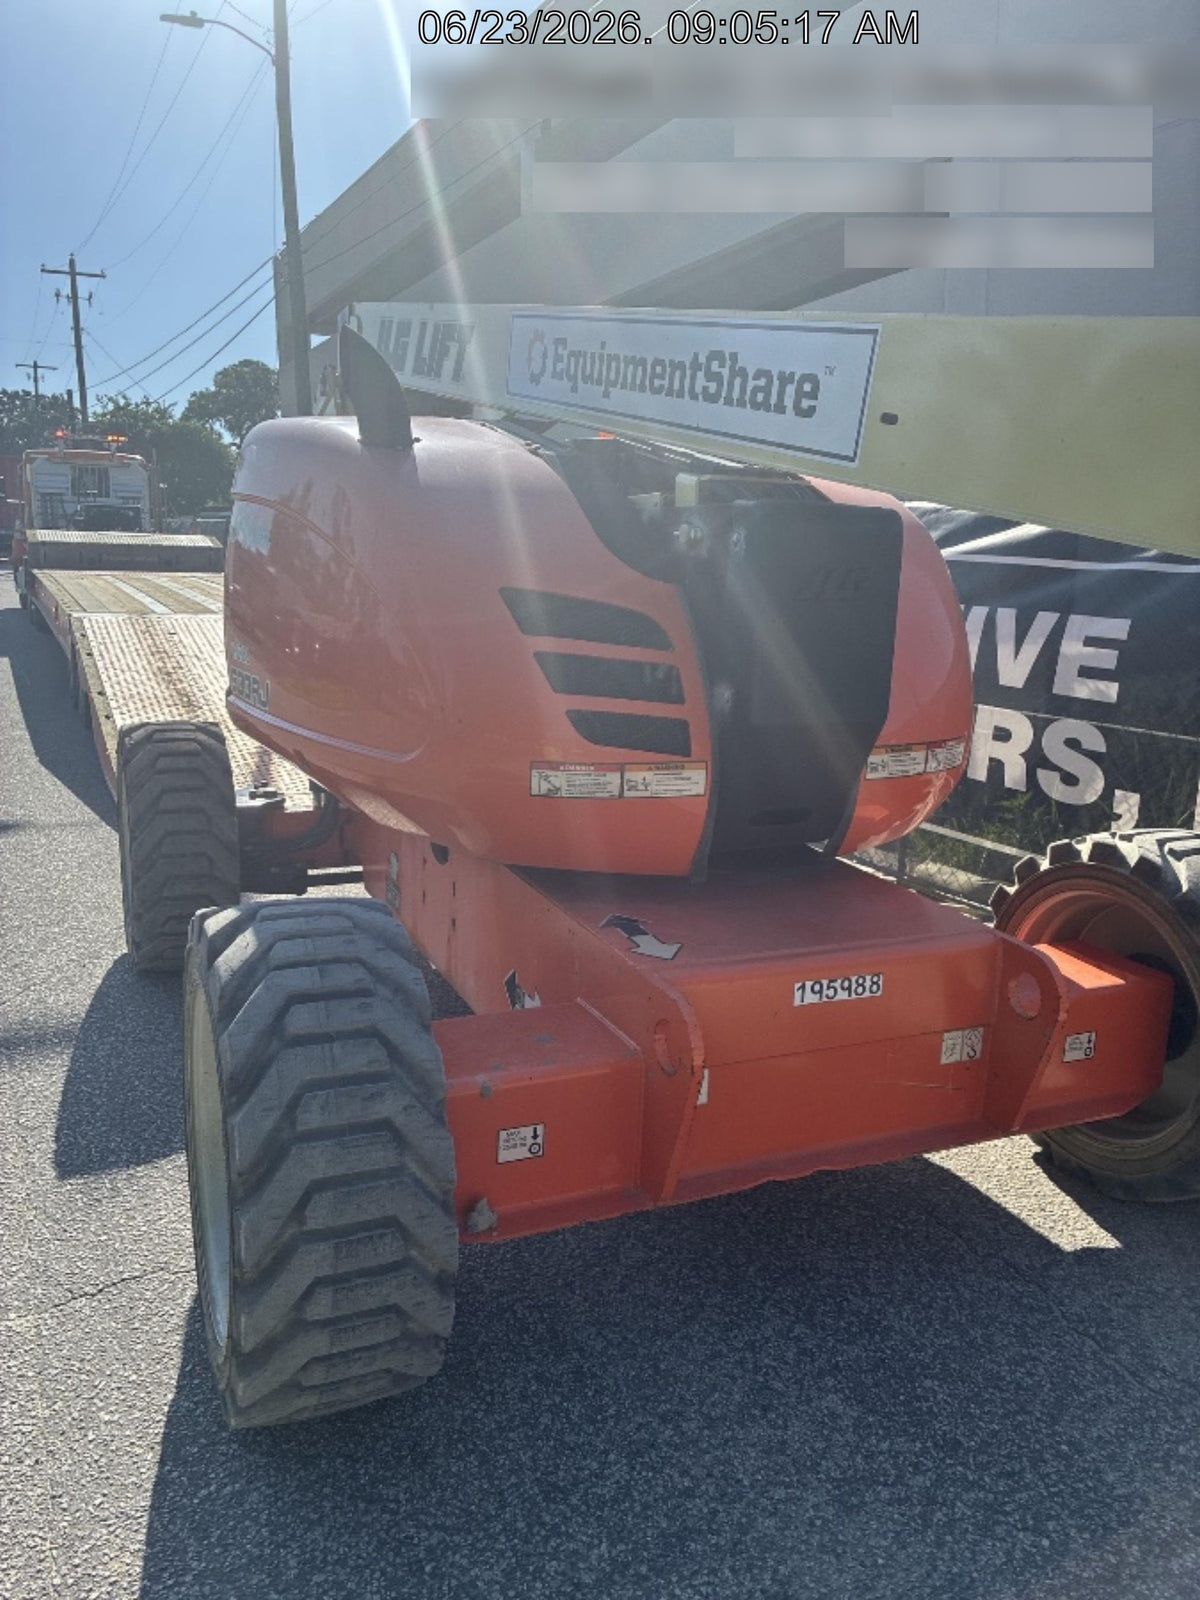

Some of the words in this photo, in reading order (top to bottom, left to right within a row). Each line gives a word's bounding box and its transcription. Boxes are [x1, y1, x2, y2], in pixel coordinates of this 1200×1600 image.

[412, 319, 476, 383] LIFT
[551, 336, 820, 419] EquipmentShare
[960, 603, 1132, 704] IVE
[796, 972, 882, 1004] 195988
